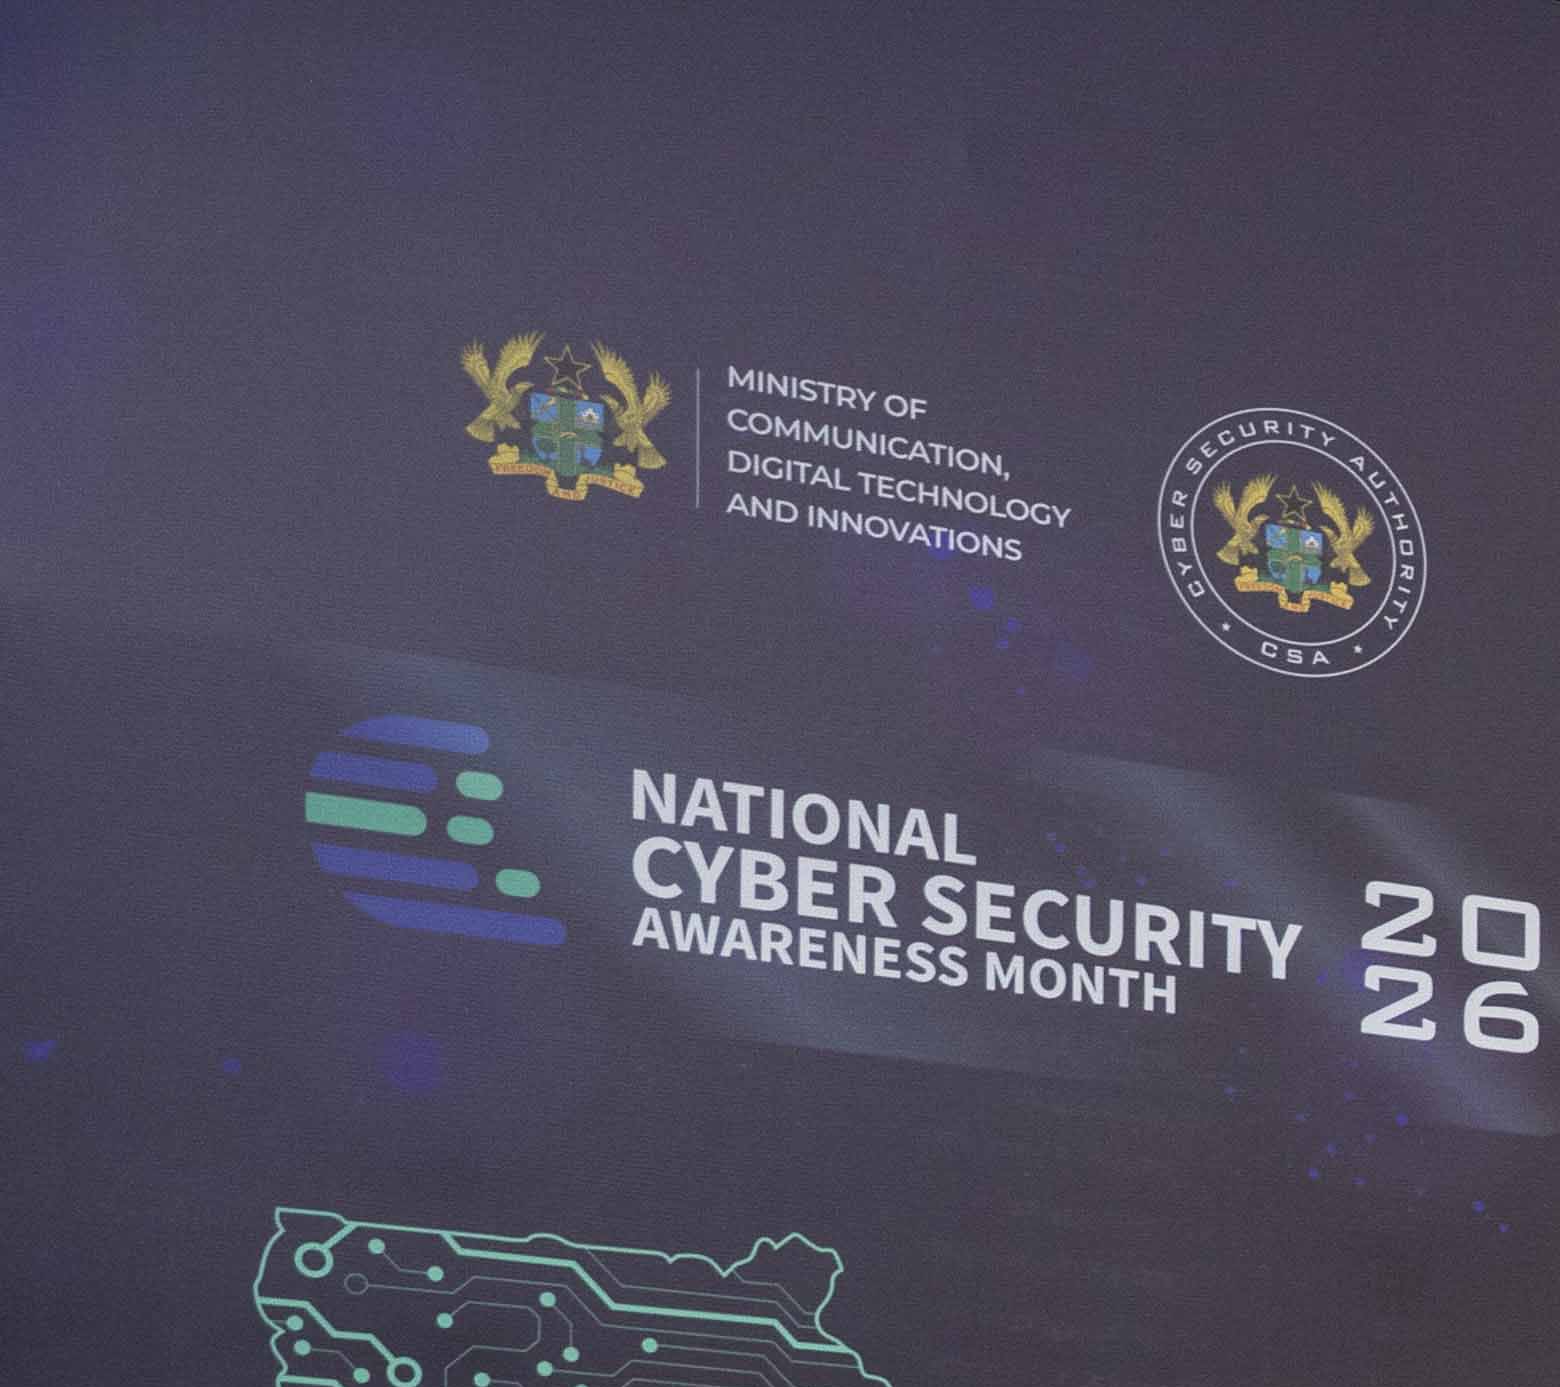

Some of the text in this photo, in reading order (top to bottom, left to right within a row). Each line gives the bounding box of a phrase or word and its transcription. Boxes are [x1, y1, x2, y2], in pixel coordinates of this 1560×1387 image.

[728, 365, 928, 420] MINISTRY OF
[727, 408, 1011, 482] COMMUNICATION,
[728, 450, 1072, 528] DIGITAL TECHNOLOGY
[726, 493, 1023, 562] AND INNOVATIONS
[1169, 419, 1415, 631] CYBER SECURITY AUTHORITY
[1260, 641, 1330, 665] CSA
[632, 769, 978, 867] NATIONAL
[632, 836, 1304, 980] CYBER SECURITY
[1361, 880, 1541, 973] 20
[632, 906, 1178, 1015] AWARENESS MONTH
[1360, 964, 1540, 1055] 26
